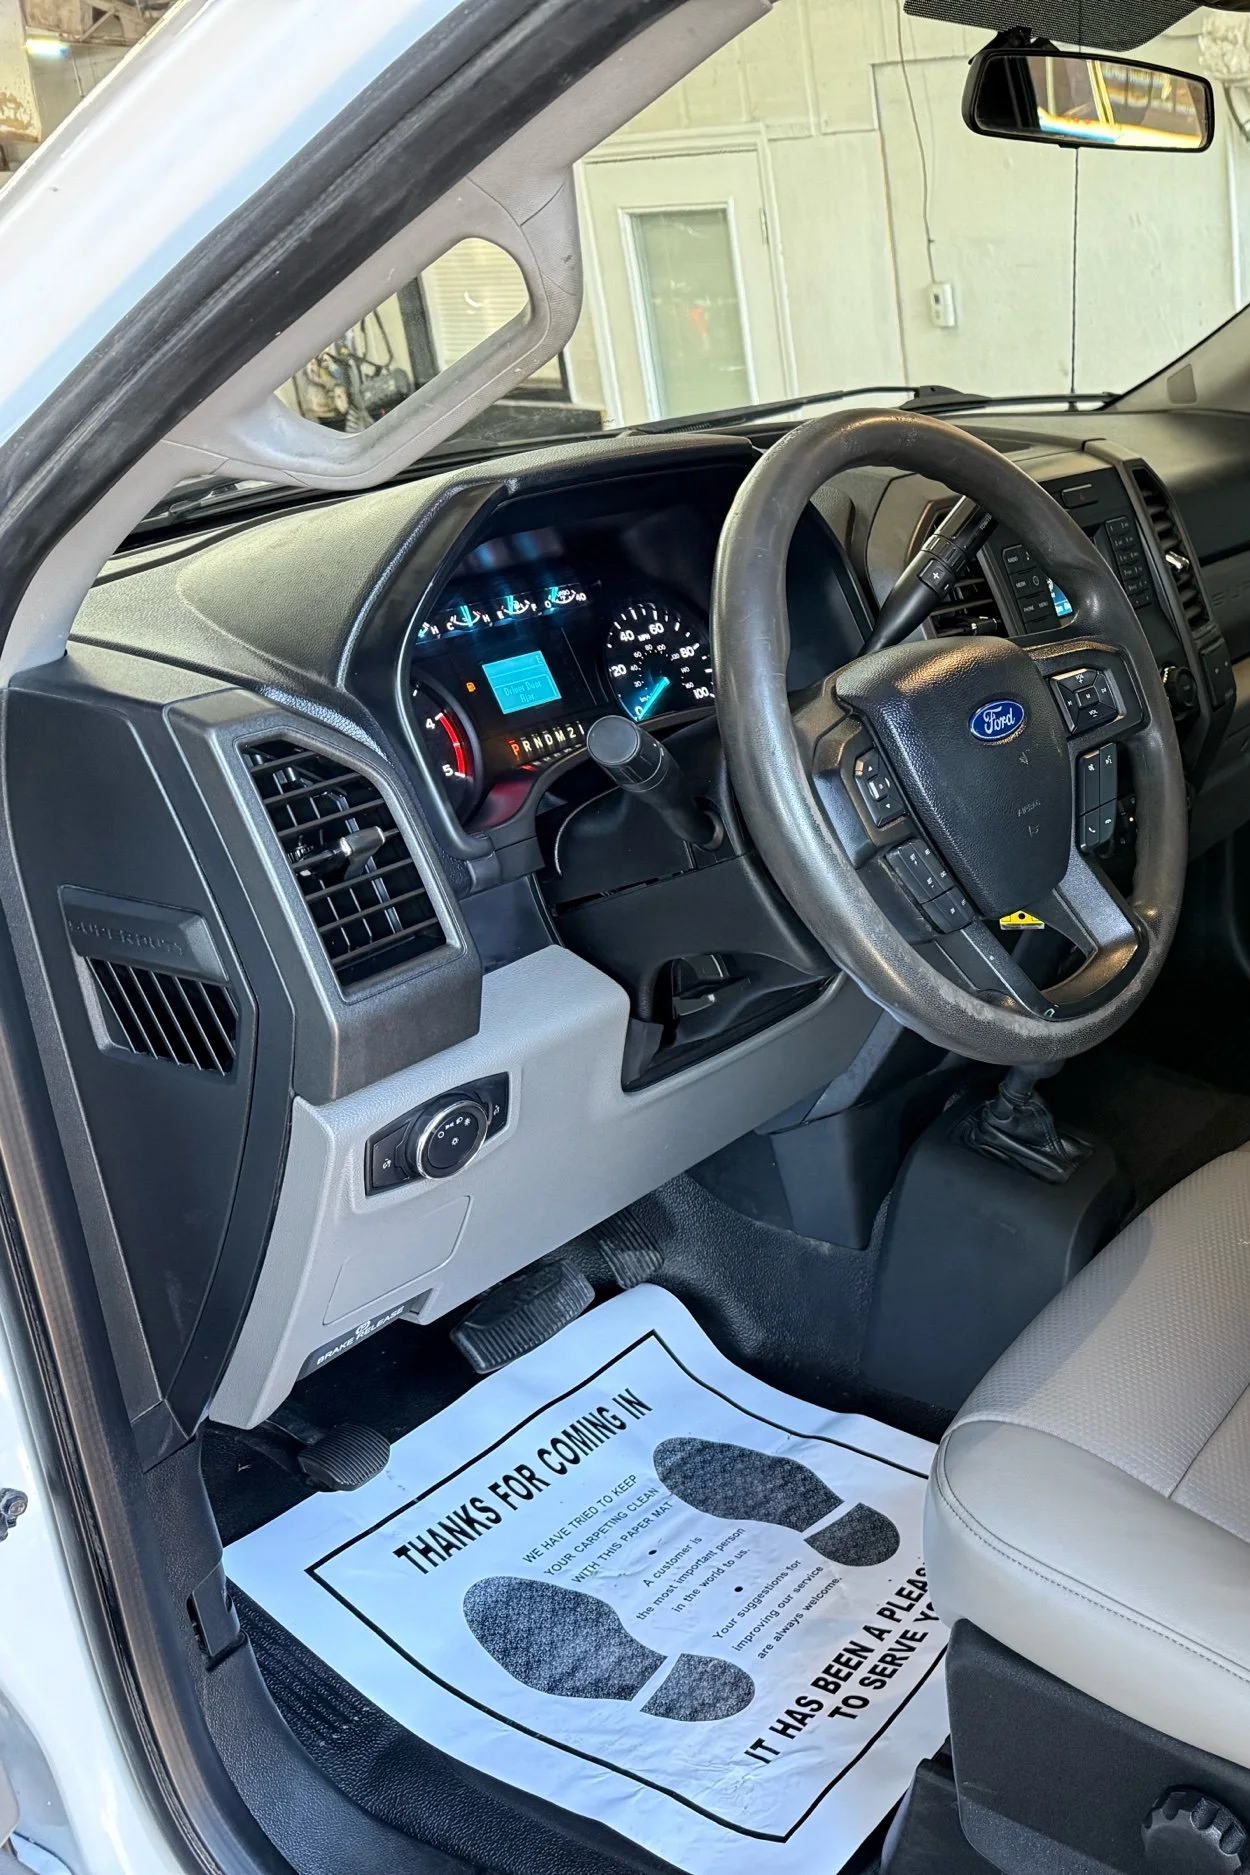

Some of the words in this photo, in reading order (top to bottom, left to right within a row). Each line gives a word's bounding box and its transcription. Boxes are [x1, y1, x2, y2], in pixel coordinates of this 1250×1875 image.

[497, 610, 505, 619] E
[531, 603, 538, 611] F
[575, 592, 587, 601] 40
[431, 625, 440, 635] H
[446, 622, 455, 630] C
[482, 614, 490, 623] H
[620, 630, 635, 641] 40
[648, 623, 664, 635] 60
[637, 633, 651, 641] MPH
[680, 646, 694, 658] 80
[611, 664, 627, 677] 20
[693, 687, 709, 699] 100
[425, 718, 436, 730] 4
[635, 706, 644, 715] 0
[983, 706, 1016, 734] Ford
[511, 743, 520, 756] P
[522, 740, 531, 752] R
[533, 737, 543, 748] N
[544, 733, 553, 745] D
[554, 730, 566, 742] M
[566, 727, 577, 738] 2
[577, 723, 585, 735] 1
[442, 763, 454, 776] 5
[317, 1337, 355, 1365] BRAKE
[356, 1306, 404, 1341] RELEASE
[393, 1497, 502, 1574] THANKS
[488, 1464, 551, 1511] FOR
[537, 1406, 627, 1475] COMING
[612, 1388, 653, 1420] IN
[522, 1548, 544, 1563] WE
[542, 1527, 571, 1550] HAVE
[568, 1506, 599, 1529] TRIED
[596, 1494, 613, 1508] TO
[612, 1474, 637, 1497] KEEP
[544, 1553, 576, 1576] YOUR
[574, 1511, 628, 1553] CARPETING
[626, 1487, 660, 1512] CLEAN
[571, 1561, 600, 1584] WITH
[597, 1542, 622, 1562] THIS
[620, 1517, 654, 1542] PAPER
[651, 1500, 673, 1518] MAT
[636, 1605, 654, 1620] the
[653, 1585, 678, 1607] most
[675, 1550, 718, 1585] important
[715, 1527, 745, 1552] person
[642, 1579, 654, 1587] A
[653, 1543, 693, 1579] customer
[690, 1536, 702, 1545] is
[671, 1601, 685, 1613] in
[683, 1588, 701, 1602] the
[699, 1567, 725, 1587] world
[723, 1558, 735, 1568] to
[734, 1548, 750, 1559] us.
[712, 1618, 738, 1640] Your
[737, 1571, 789, 1618] suggestions
[786, 1558, 802, 1571] for
[732, 1608, 780, 1652] improving
[777, 1593, 794, 1608] our
[793, 1565, 824, 1594] service
[757, 1643, 774, 1659] are
[773, 1611, 804, 1642] always
[802, 1577, 843, 1611] welcome.
[828, 1695, 870, 1720] TO
[859, 1629, 929, 1690] SERVE
[744, 1738, 780, 1764] IT
[768, 1695, 824, 1739] HAS
[810, 1640, 875, 1694] BEEN
[862, 1625, 893, 1642] A
